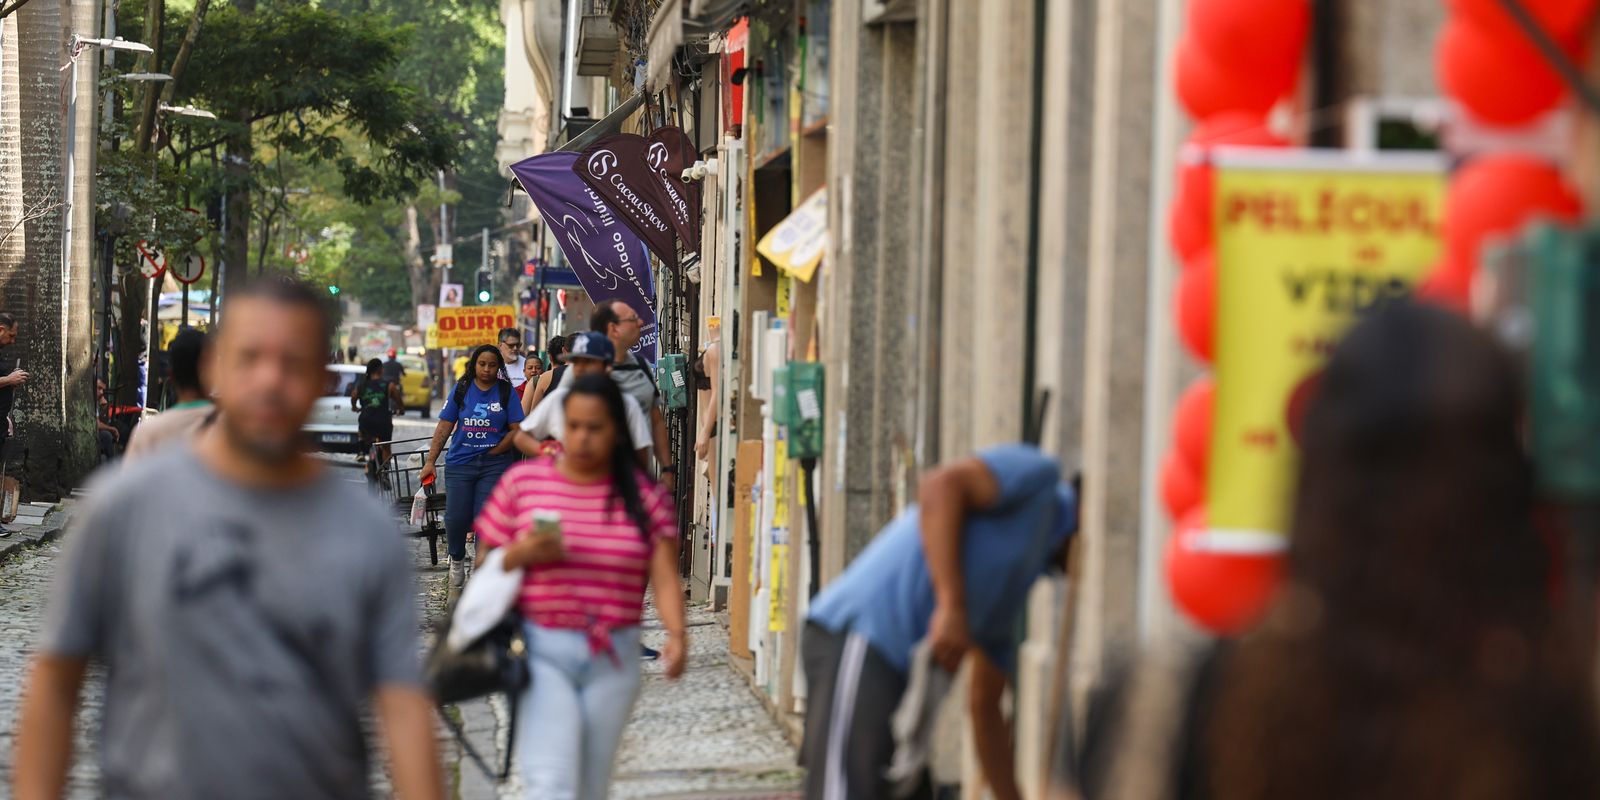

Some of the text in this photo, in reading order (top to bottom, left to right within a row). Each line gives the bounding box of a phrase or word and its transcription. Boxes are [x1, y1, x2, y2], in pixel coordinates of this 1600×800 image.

[610, 173, 668, 232] CacauShow
[439, 315, 513, 331] OURO
[470, 402, 489, 419] 5
[463, 417, 491, 427] anos
